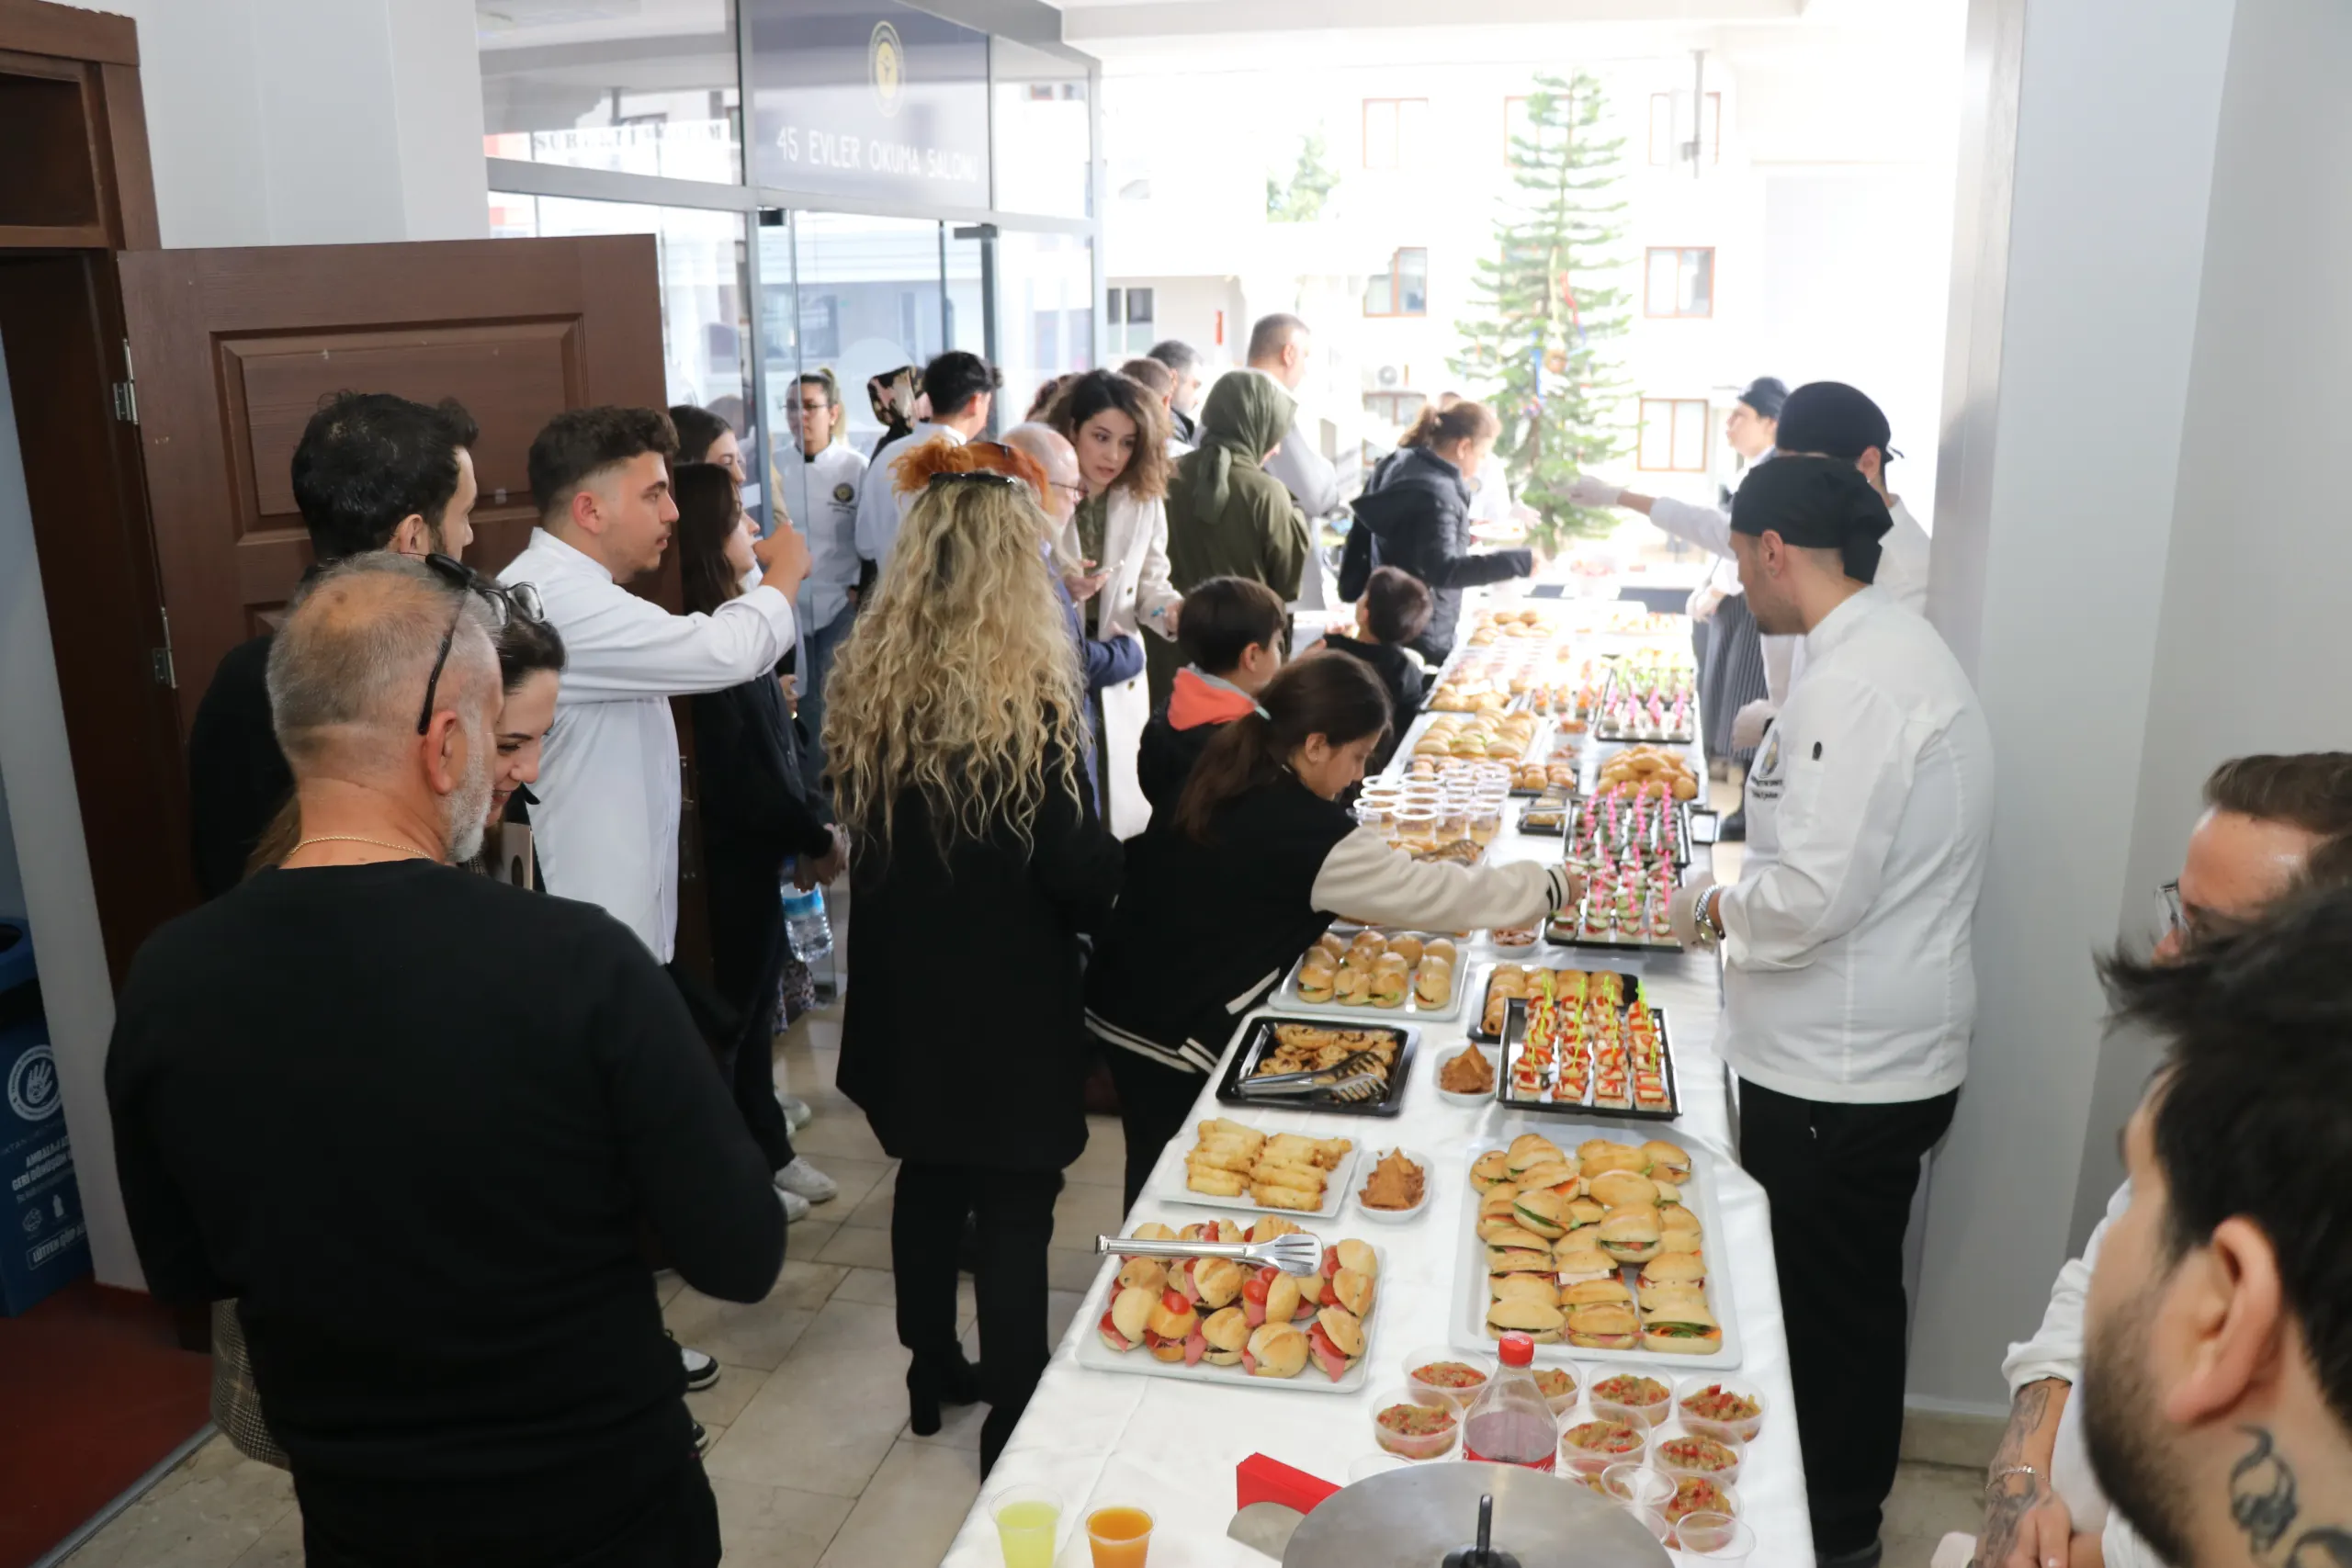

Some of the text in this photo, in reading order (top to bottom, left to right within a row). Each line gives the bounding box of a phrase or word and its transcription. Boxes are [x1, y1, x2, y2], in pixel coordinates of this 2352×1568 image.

[776, 126, 978, 183] 45 EVLER OKUMA SALONU
